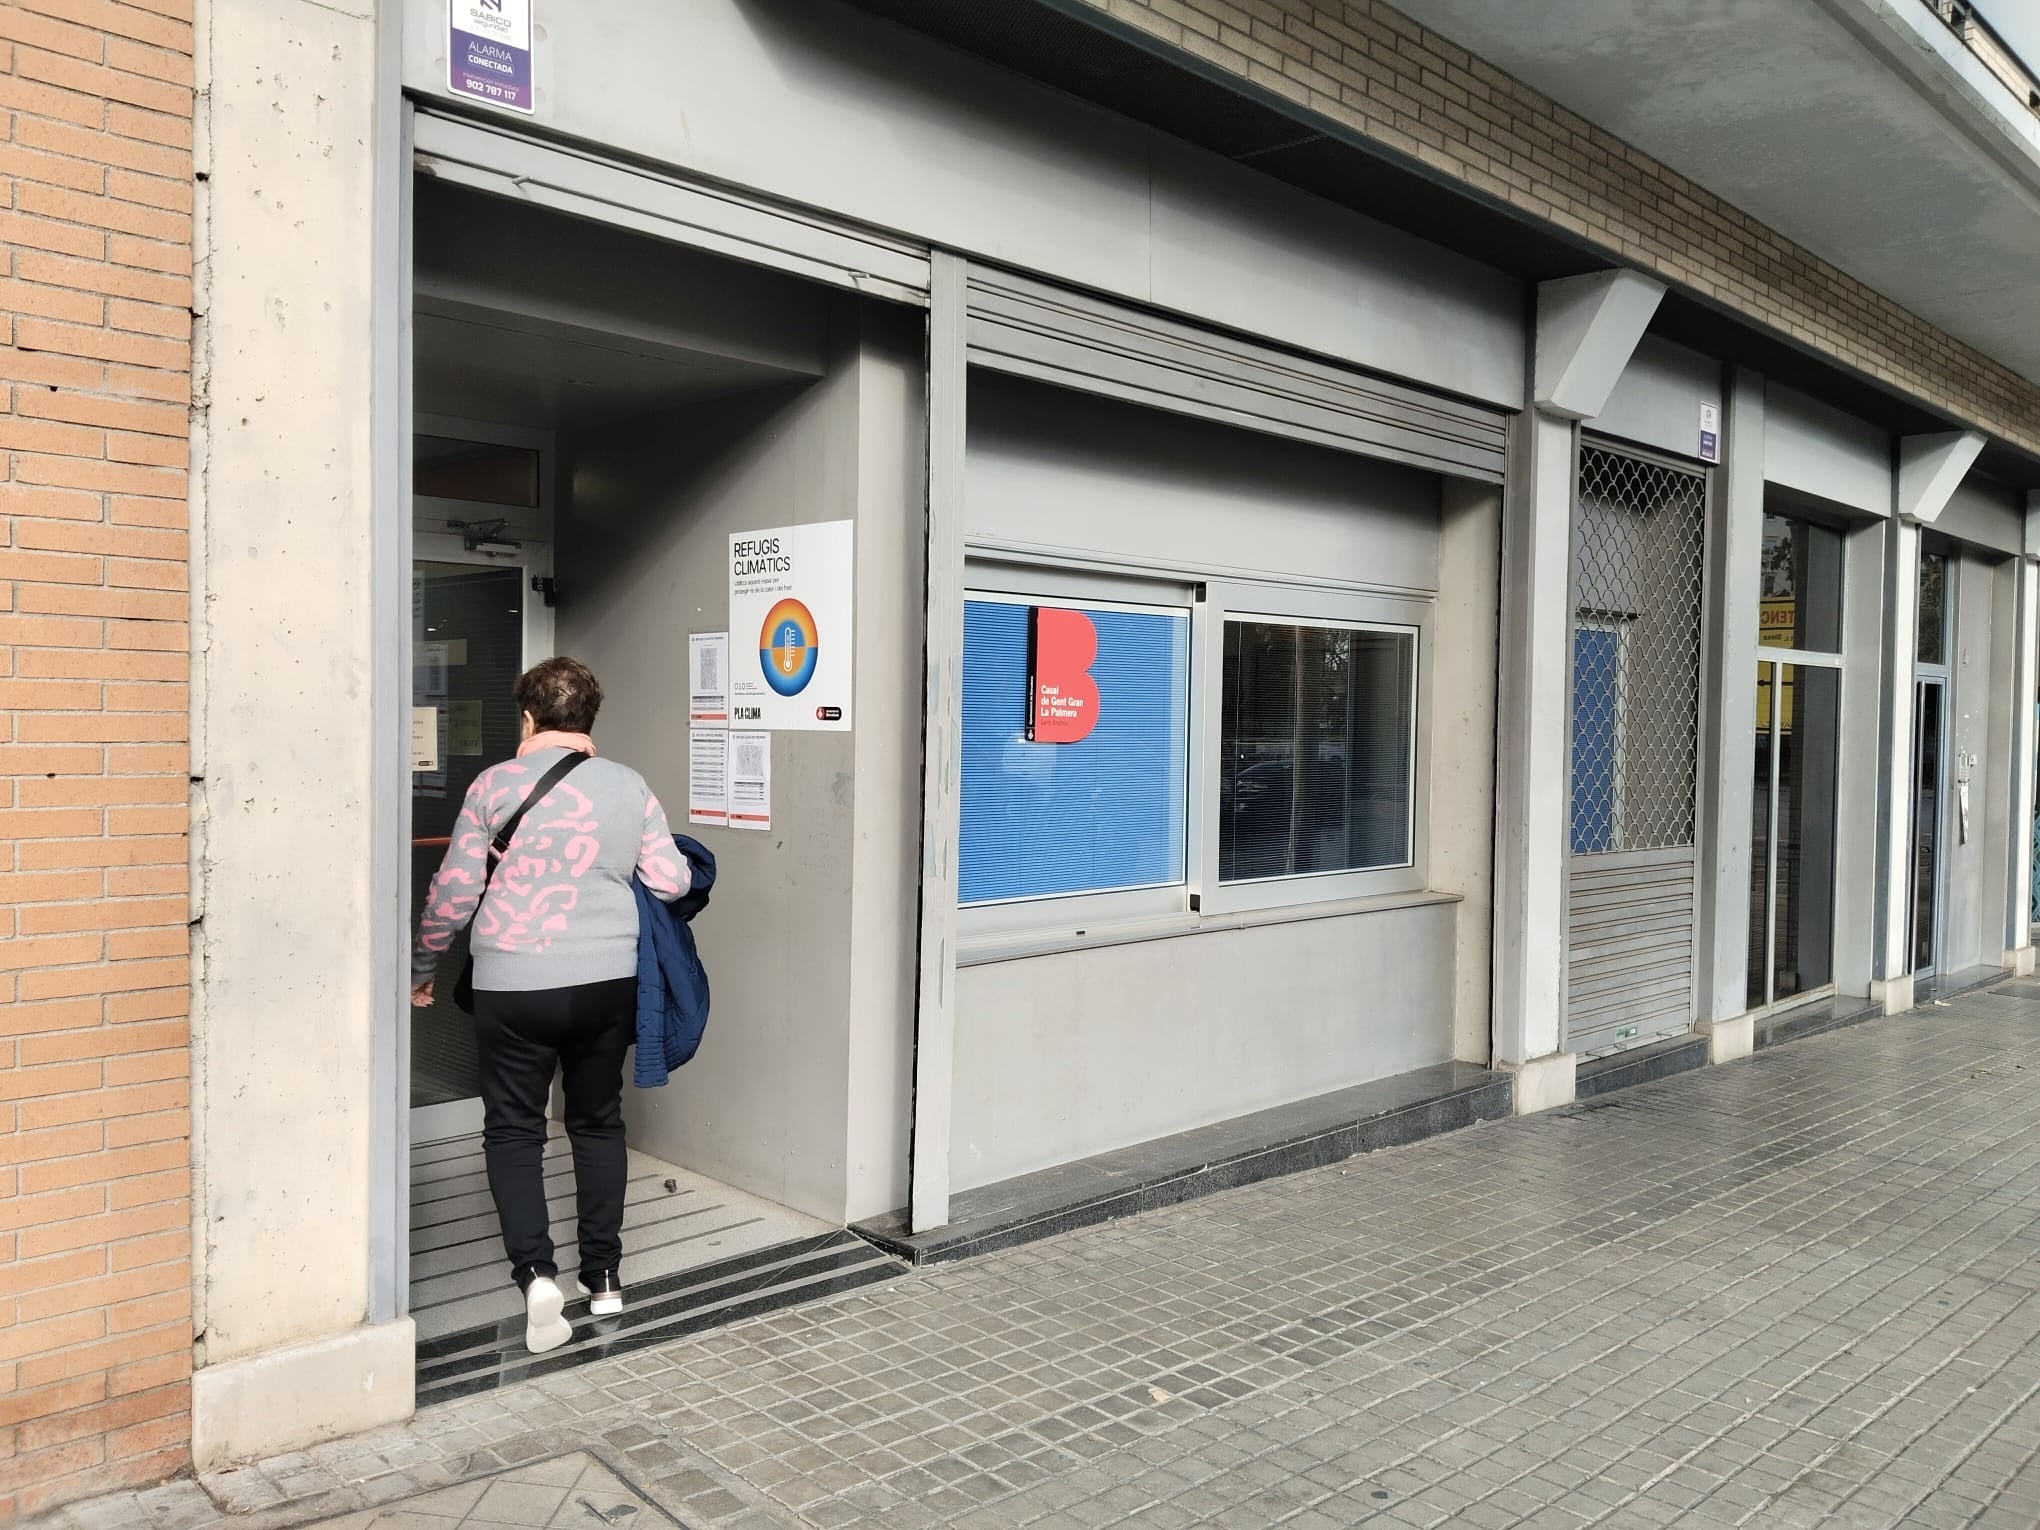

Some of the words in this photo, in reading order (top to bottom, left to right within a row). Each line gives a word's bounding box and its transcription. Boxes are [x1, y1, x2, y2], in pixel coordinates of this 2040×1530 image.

[470, 8, 511, 28] SABICO
[468, 41, 513, 63] ALARMA
[468, 54, 513, 75] CONECTADA
[466, 79, 484, 92] 902
[485, 84, 502, 97] 787
[504, 89, 516, 100] 117
[734, 538, 780, 558] REFUGIS
[734, 554, 791, 576] CLIMÀTICS
[1041, 685, 1059, 695] Casal
[1041, 697, 1049, 706] de
[1051, 697, 1067, 706] Gent
[1068, 697, 1084, 707] Gran
[734, 707, 744, 720] PLA
[744, 707, 761, 720] CLIMA
[1040, 707, 1049, 717] La
[1051, 707, 1077, 718] Palmera
